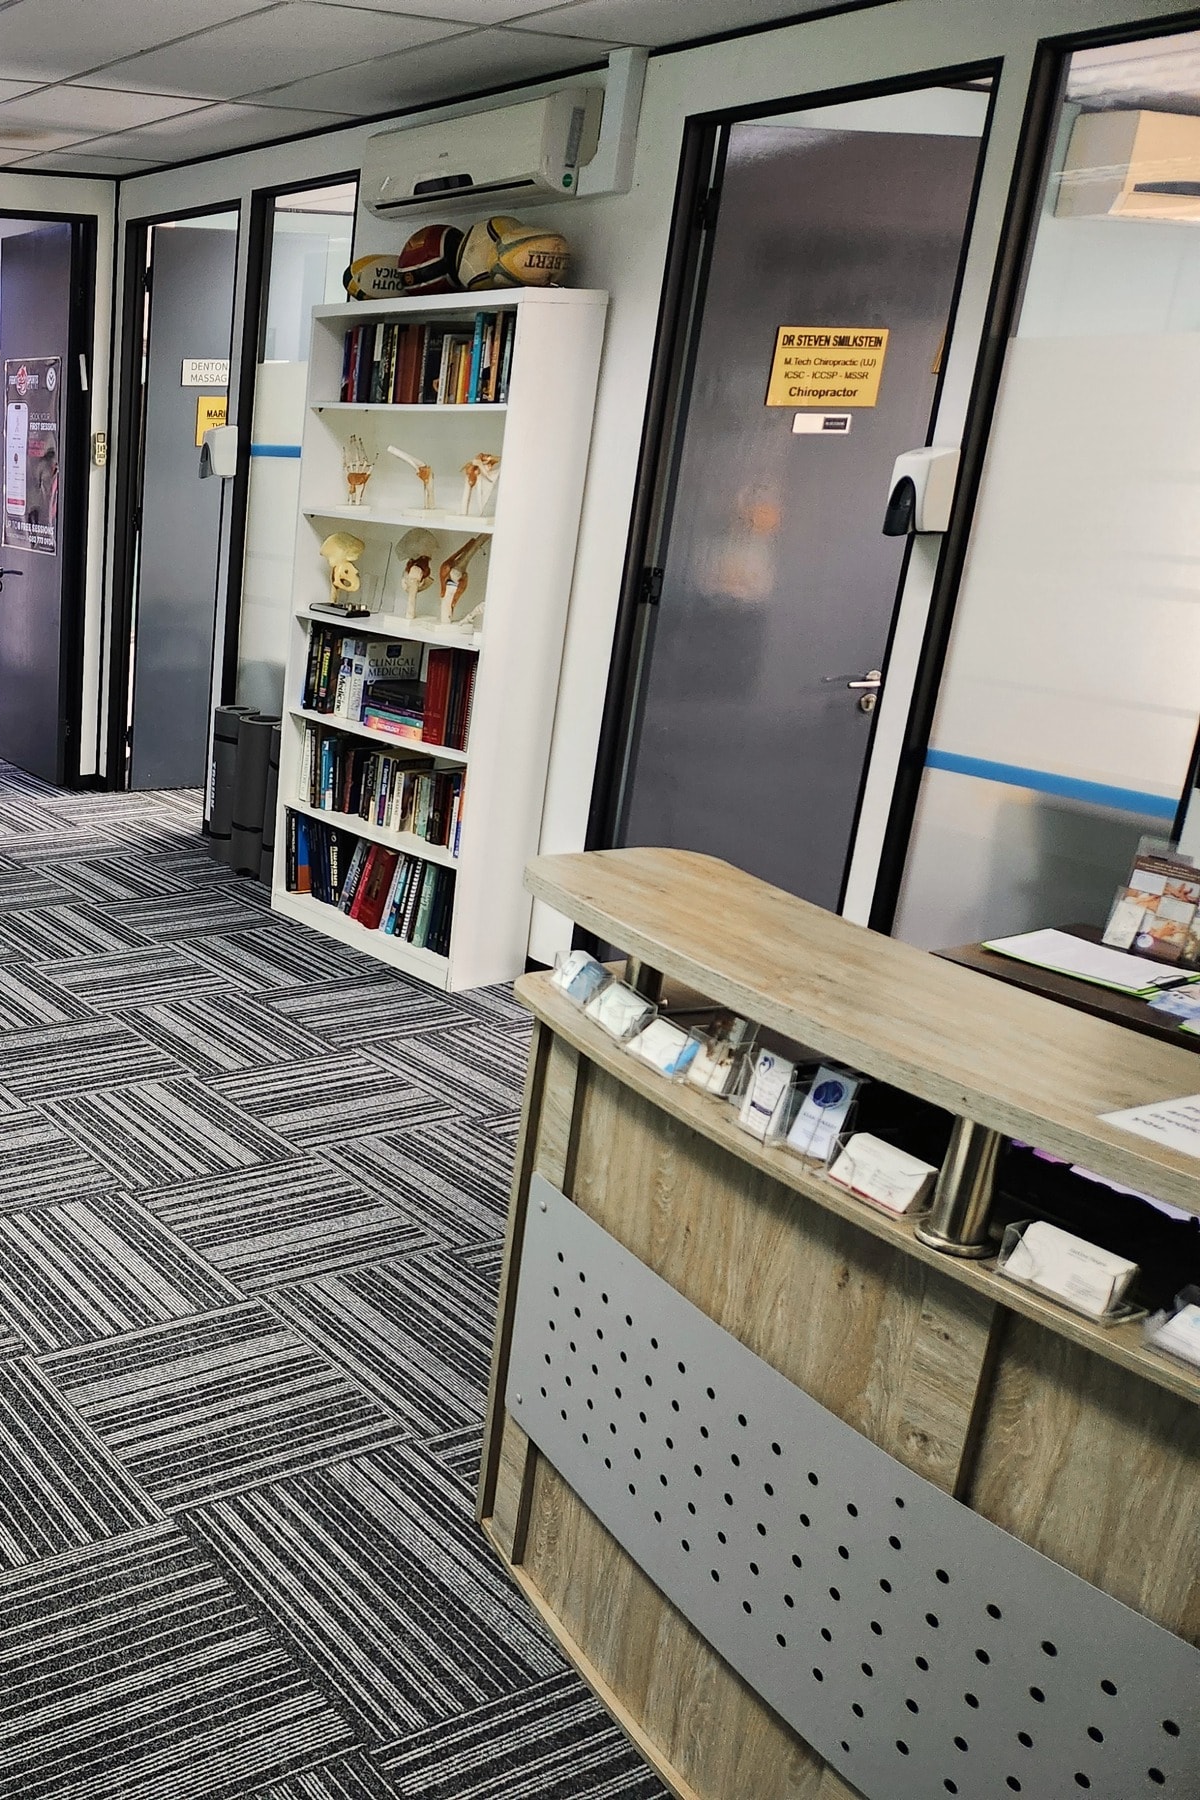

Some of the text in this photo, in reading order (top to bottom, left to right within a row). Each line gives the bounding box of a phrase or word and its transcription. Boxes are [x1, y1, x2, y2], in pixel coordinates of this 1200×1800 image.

[782, 335, 883, 347] DR STEVEN SMILKSTEIN
[191, 362, 228, 371] DENTON
[784, 357, 812, 366] M.Tech
[813, 358, 858, 368] Chiropractic
[784, 371, 805, 379] ICSC
[812, 371, 838, 379] ICCSP
[844, 372, 869, 380] MSSR
[788, 386, 858, 398] Chiropractor
[368, 658, 415, 667] CLINICAL
[368, 666, 416, 677] MEDICINE
[336, 674, 346, 712] Medicine
